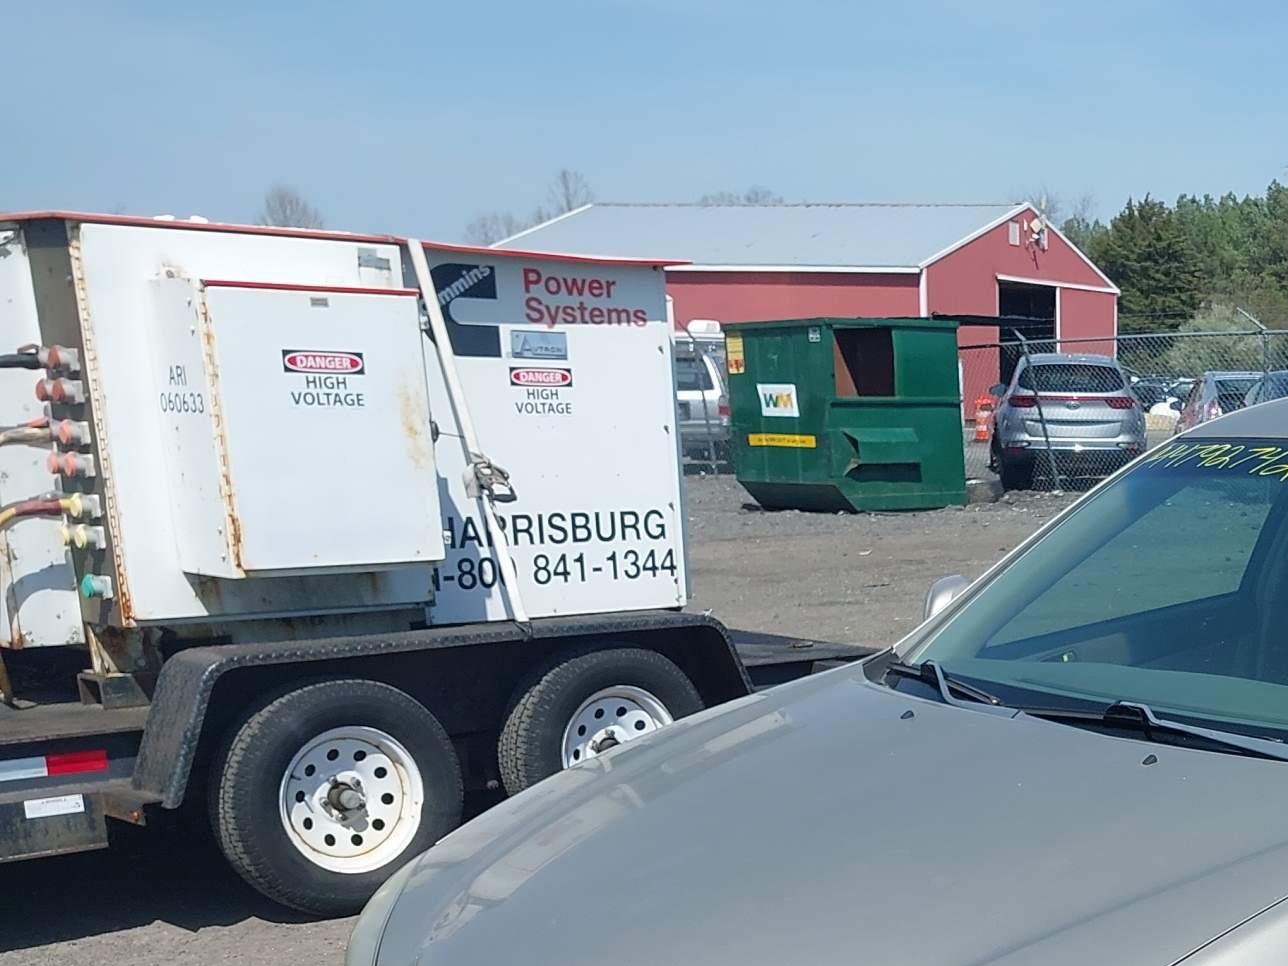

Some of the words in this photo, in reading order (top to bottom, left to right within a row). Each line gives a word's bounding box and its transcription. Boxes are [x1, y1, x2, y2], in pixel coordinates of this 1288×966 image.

[438, 264, 490, 305] mmins
[523, 268, 616, 298] Power
[525, 297, 648, 328] Systems
[295, 355, 351, 369] DANGER
[169, 365, 187, 386] ARI
[306, 376, 347, 390] HIGH
[519, 371, 562, 383] DANGER
[291, 392, 365, 407] VOLTAGE
[527, 389, 559, 400] HIGH
[763, 393, 793, 408] WM
[160, 393, 204, 414] 060633
[515, 402, 572, 414] VOLTAGE
[533, 548, 677, 585] 841-1344
